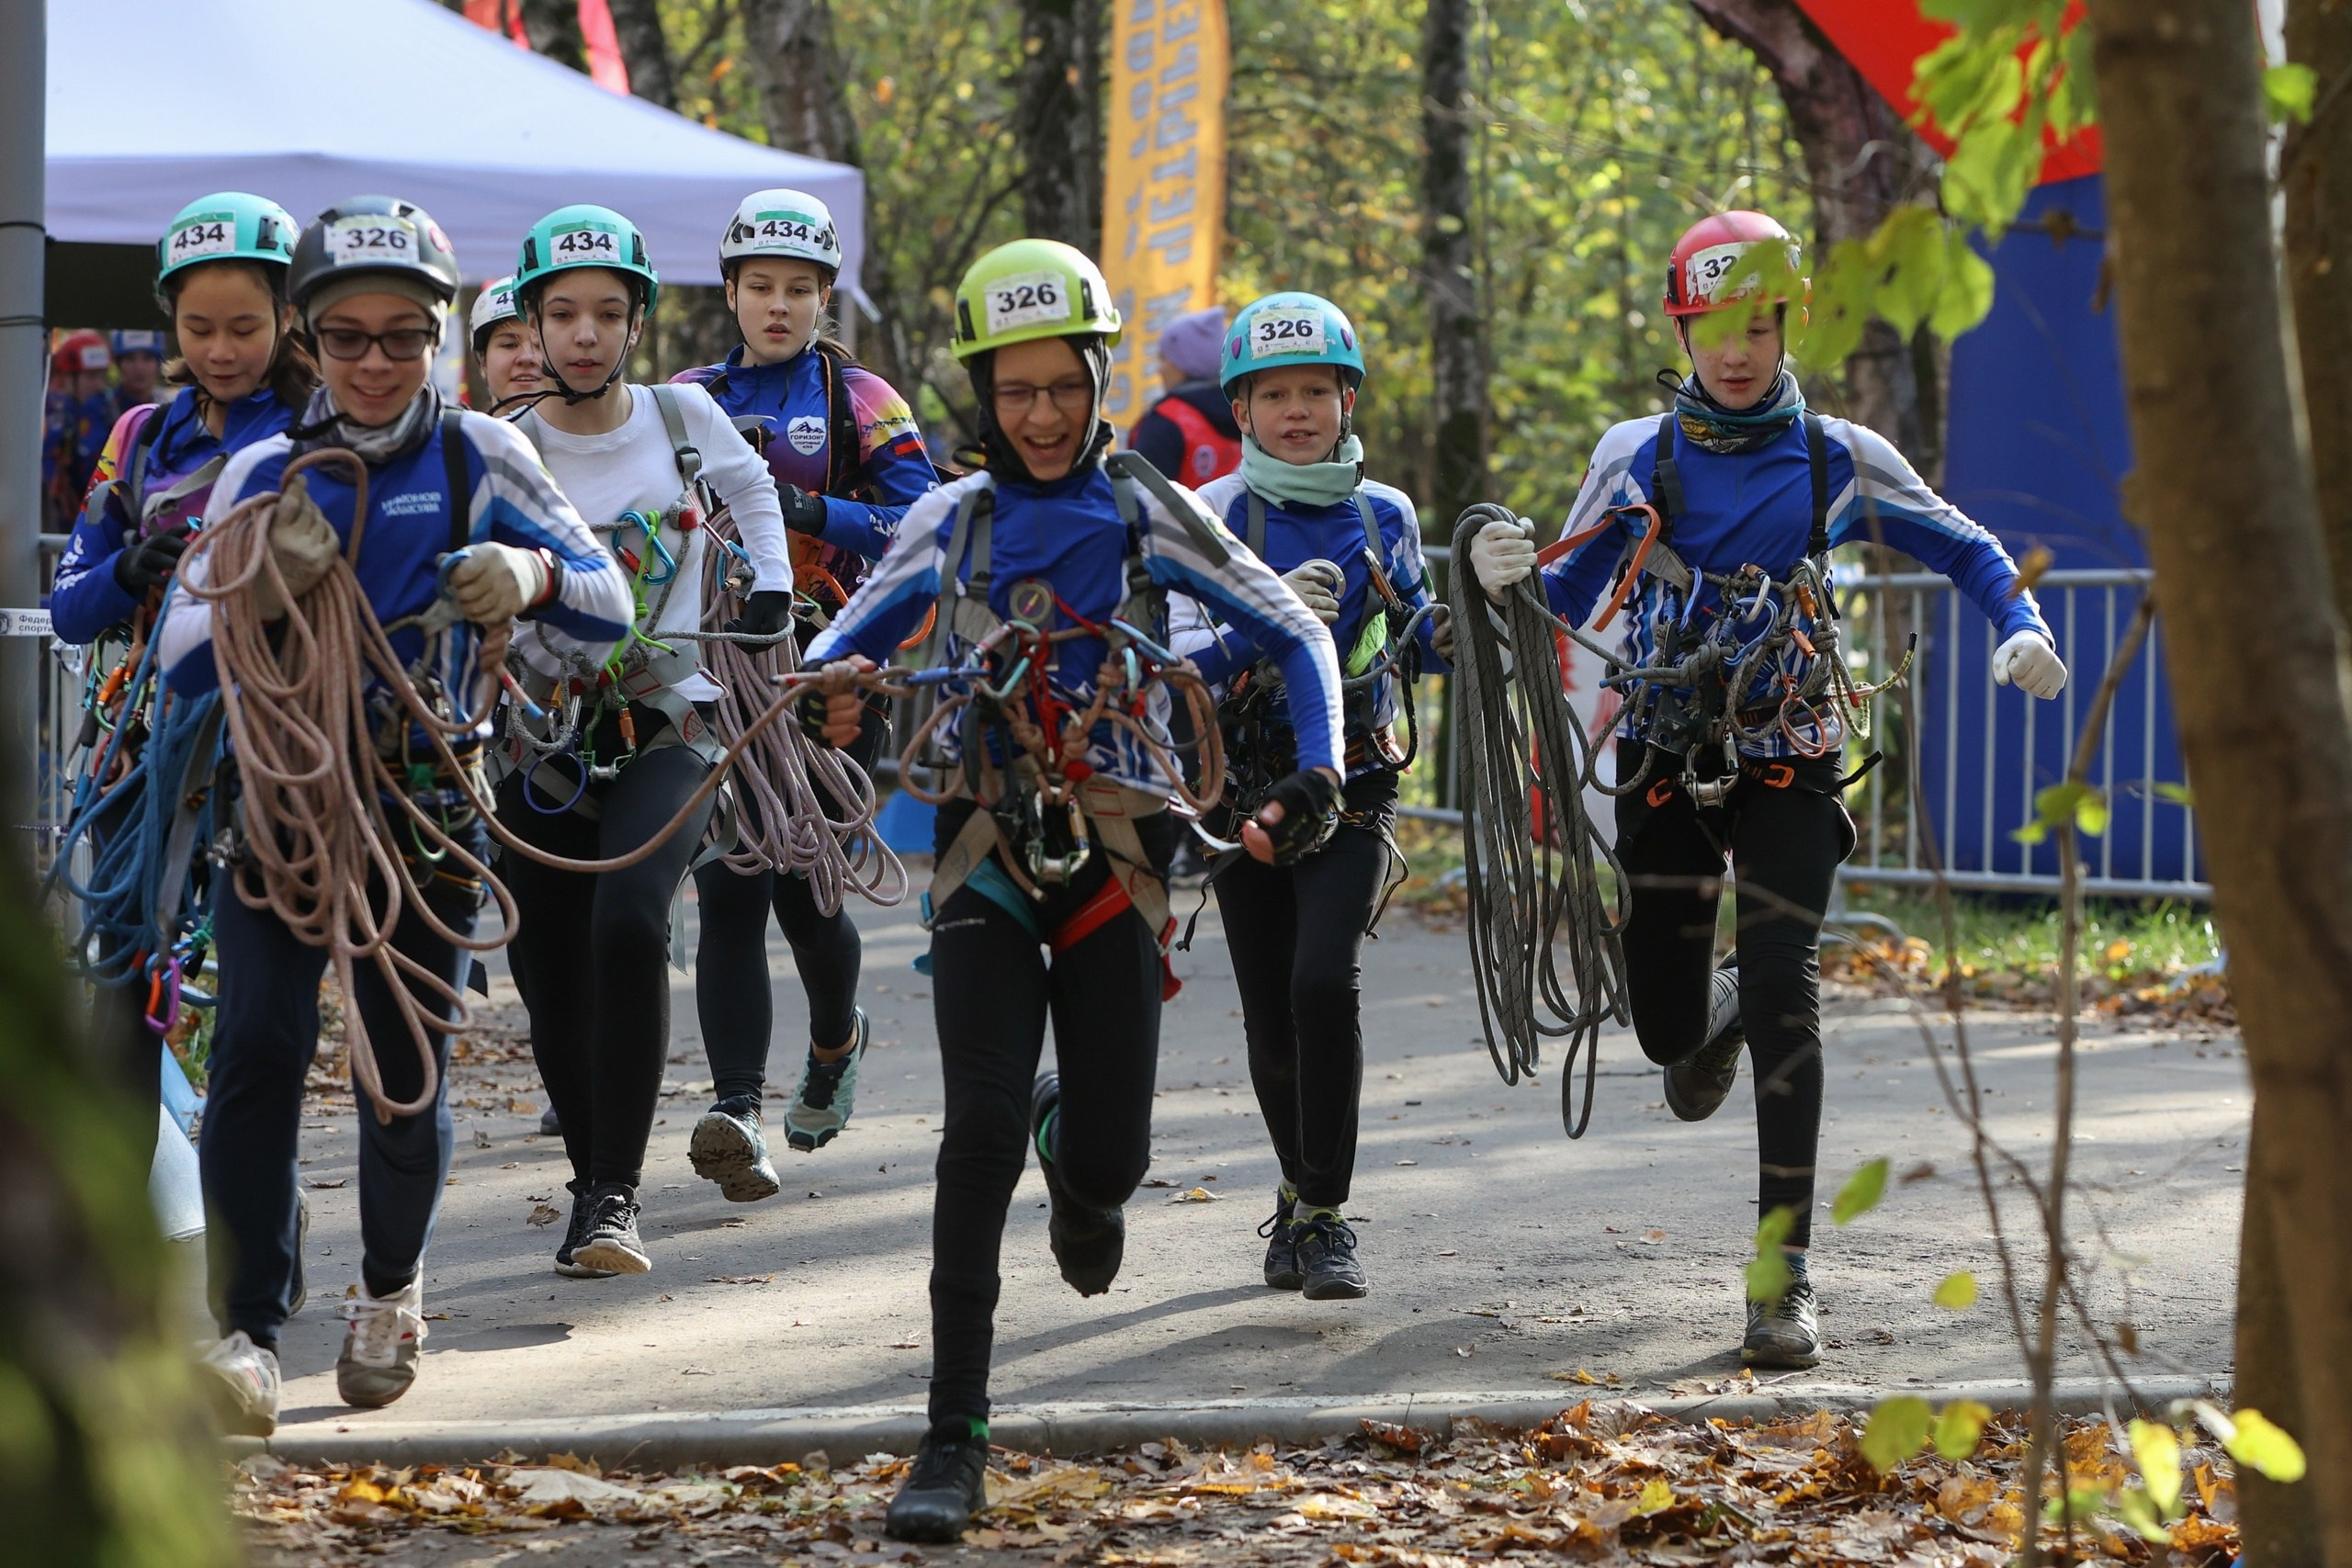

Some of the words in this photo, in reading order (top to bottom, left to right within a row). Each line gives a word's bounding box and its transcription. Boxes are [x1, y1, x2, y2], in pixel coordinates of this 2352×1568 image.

[174, 222, 225, 250] 434
[346, 227, 408, 250] 326
[559, 231, 613, 253] 434
[761, 220, 808, 242] 434
[996, 282, 1057, 313] 326
[1260, 319, 1313, 342] 326
[18, 615, 52, 625] Федер
